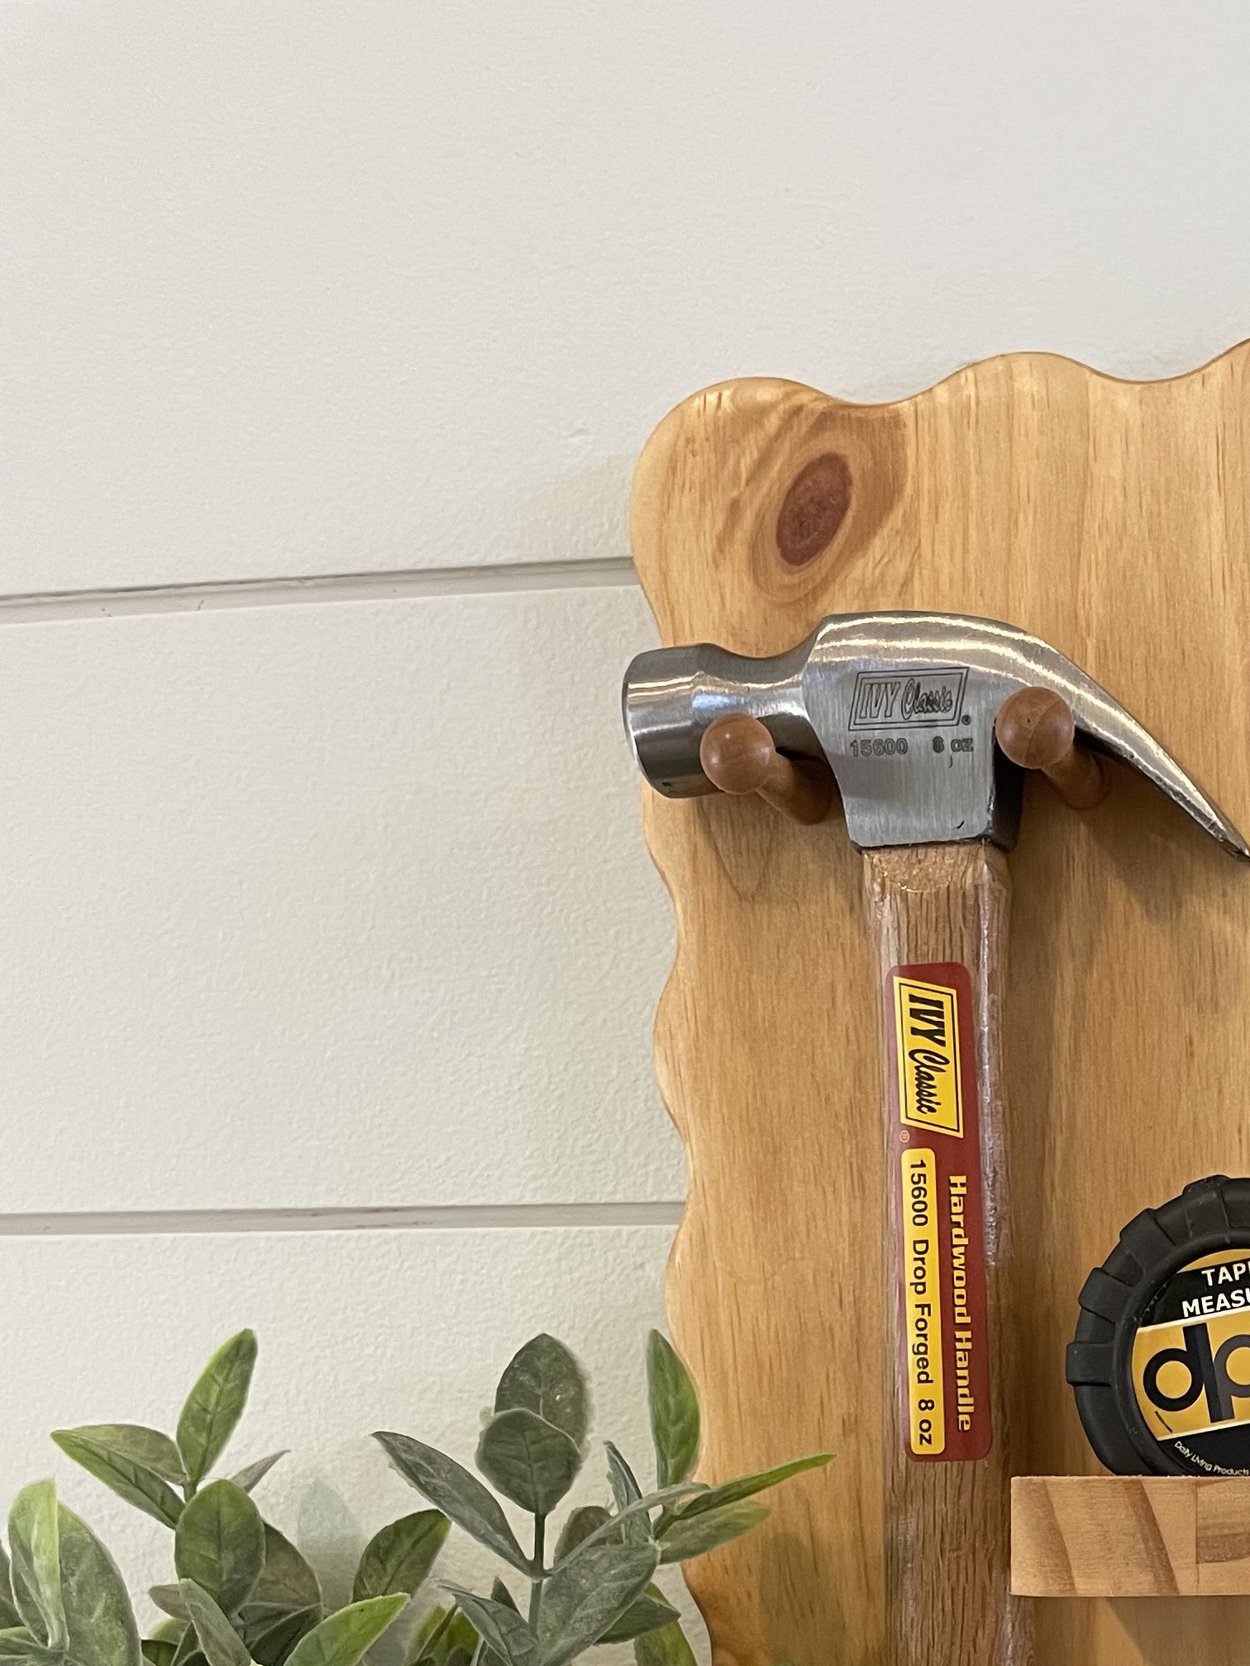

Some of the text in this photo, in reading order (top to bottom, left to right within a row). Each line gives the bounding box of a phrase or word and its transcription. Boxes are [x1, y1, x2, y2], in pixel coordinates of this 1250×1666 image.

[859, 681, 901, 719] IVY
[850, 735, 974, 758] 15600 8 oz
[908, 993, 950, 1115] IVY Classic
[910, 1159, 935, 1446] 15600 Drop Forged 8 oz
[949, 1175, 974, 1432] Hardwood Handle
[1174, 1440, 1193, 1459] Daily
